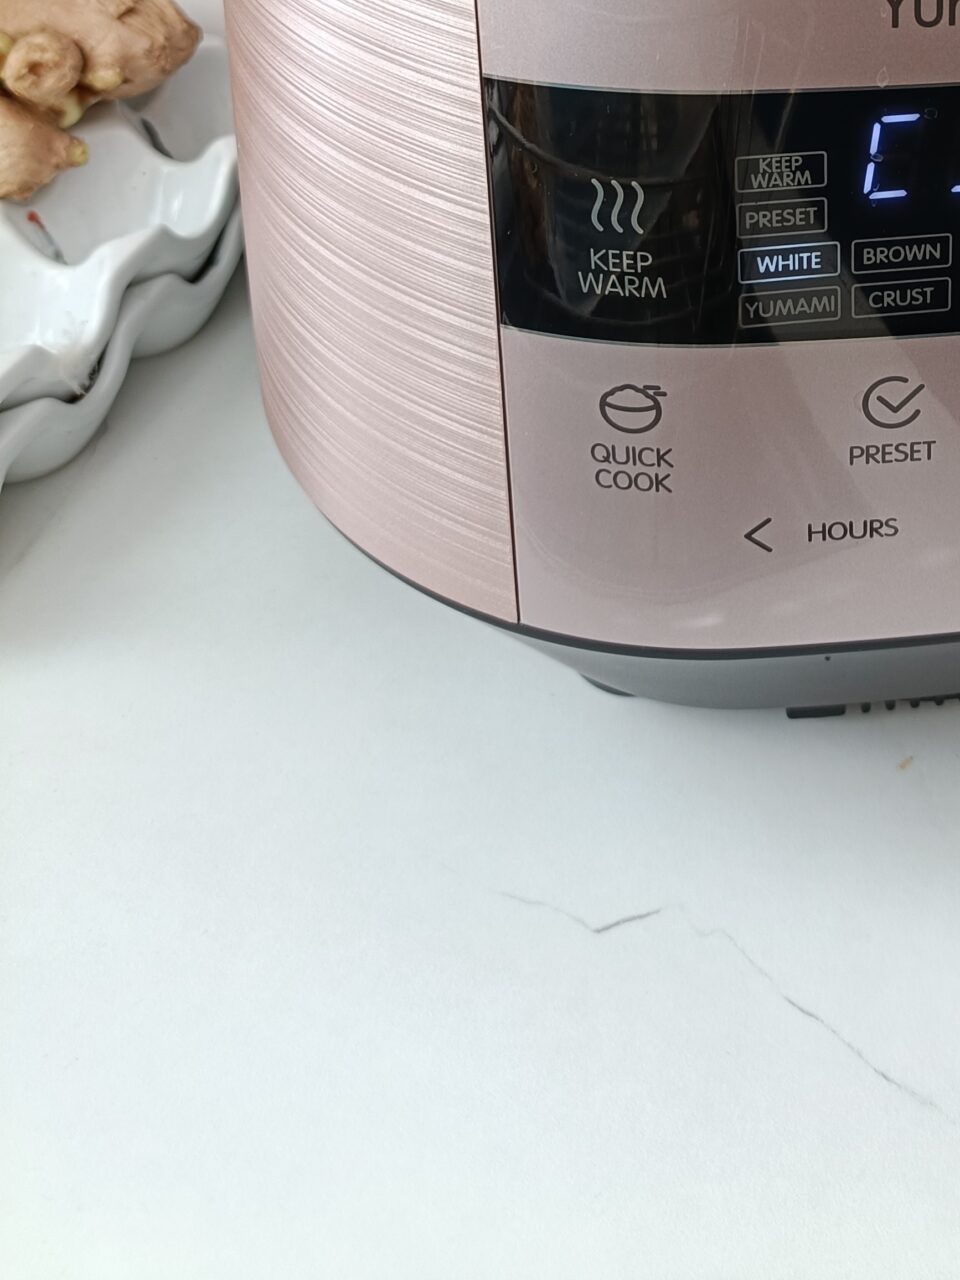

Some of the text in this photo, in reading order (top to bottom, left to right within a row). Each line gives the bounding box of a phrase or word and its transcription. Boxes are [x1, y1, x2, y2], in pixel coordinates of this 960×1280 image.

[758, 156, 804, 173] KEEP
[750, 170, 812, 189] WARM
[745, 207, 818, 229] PRESET
[589, 248, 653, 274] KEEP
[756, 251, 822, 274] WHITE
[862, 242, 942, 265] BROWN
[577, 271, 667, 299] WARM
[745, 294, 836, 319] YUMAMI
[868, 287, 935, 310] CRUST
[590, 442, 675, 469] QUICK
[849, 440, 937, 466] PRESET
[594, 468, 673, 494] COOK
[807, 517, 899, 543] HOURS
